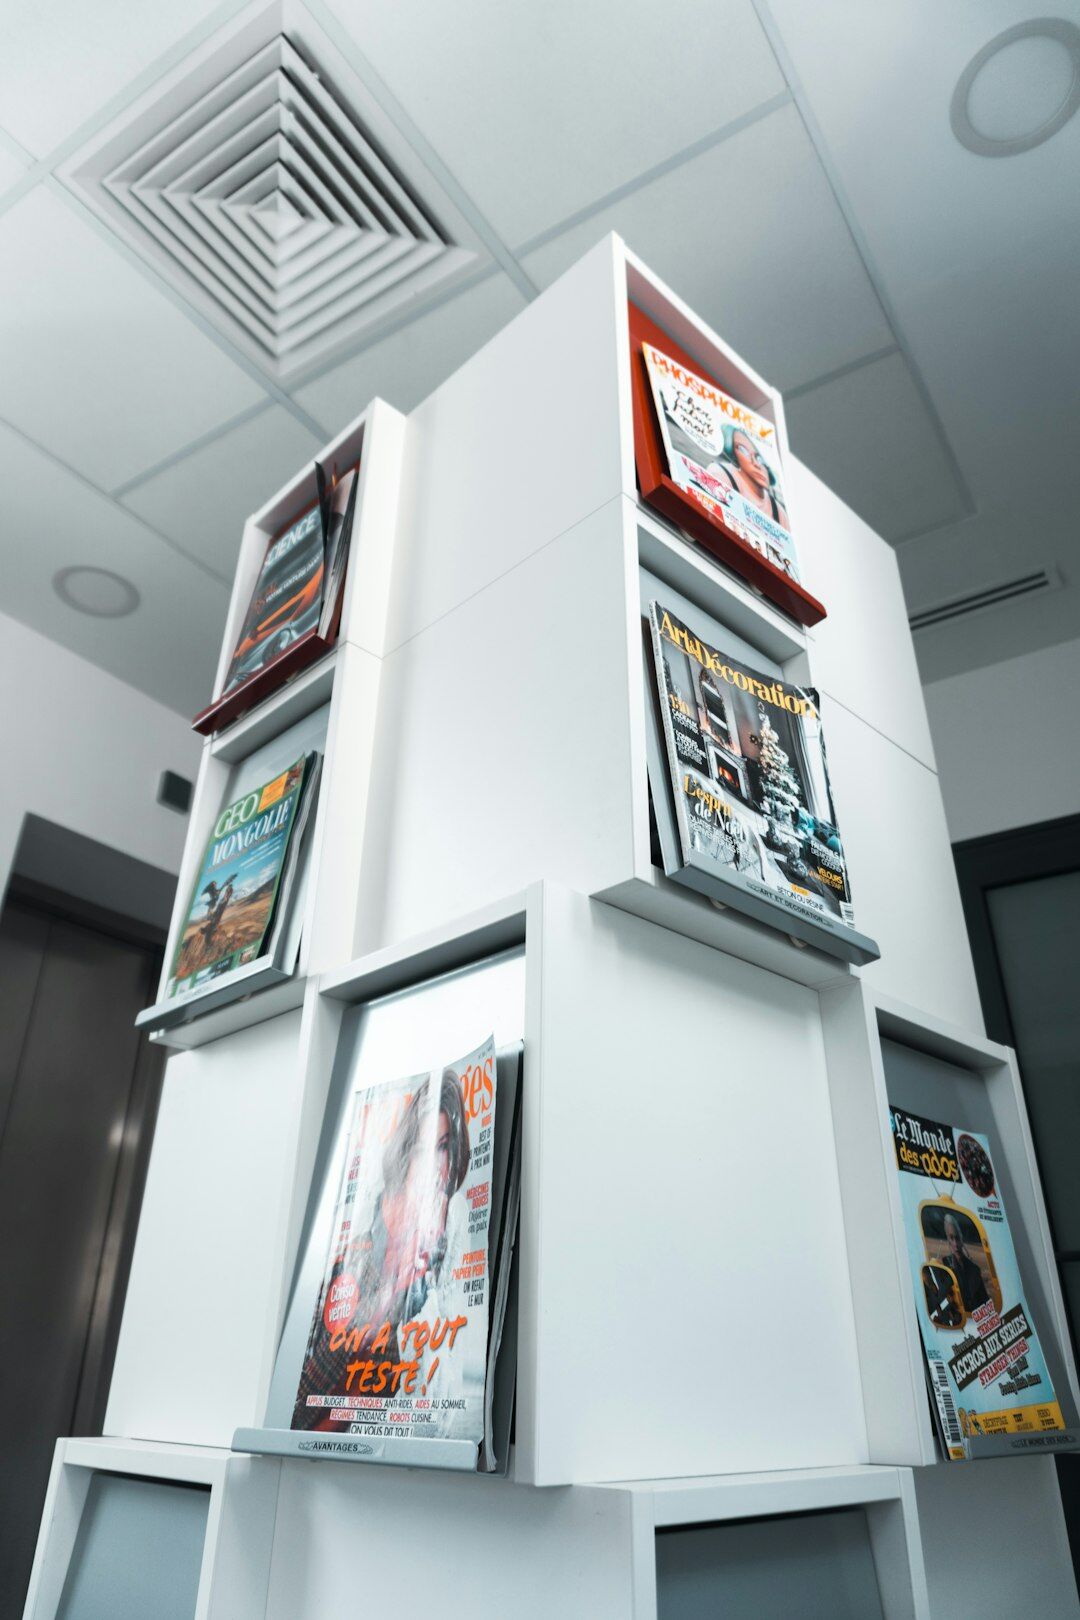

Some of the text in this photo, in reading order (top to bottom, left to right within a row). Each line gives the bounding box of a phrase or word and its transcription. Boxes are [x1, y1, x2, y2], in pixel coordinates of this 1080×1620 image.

[264, 510, 318, 567] CIENCE
[215, 793, 258, 838] GEO
[695, 799, 747, 842] de Noël
[212, 796, 292, 866] MONGOLIE
[817, 867, 843, 885] VELOURS
[760, 888, 772, 899] ART
[774, 895, 783, 904] ET
[479, 1130, 487, 1143] BEST
[894, 1112, 909, 1141] Le
[906, 1117, 955, 1155] Monde
[900, 1141, 960, 1181] des ados
[475, 1220, 487, 1235] paix
[452, 1263, 486, 1281] PAPIER PEINT
[330, 1283, 355, 1302] Conso
[463, 1279, 485, 1294] ON REFAIT
[468, 1293, 483, 1307] LE MUR
[329, 1314, 468, 1354] ON A TOUT
[952, 1314, 1028, 1384] ACCROS AUX SÉRIES
[979, 1337, 1029, 1386] STRANGER THINGS
[348, 1398, 383, 1409] TECHNIQUES
[415, 1400, 430, 1409] AIDES
[431, 1400, 440, 1409] AU
[389, 1412, 411, 1422] ROBOTS
[351, 1425, 362, 1434] ON
[364, 1426, 383, 1436] VOUS
[384, 1427, 394, 1436] DIT
[395, 1427, 409, 1437] TOUT
[313, 1442, 358, 1452] AVANTAGES
